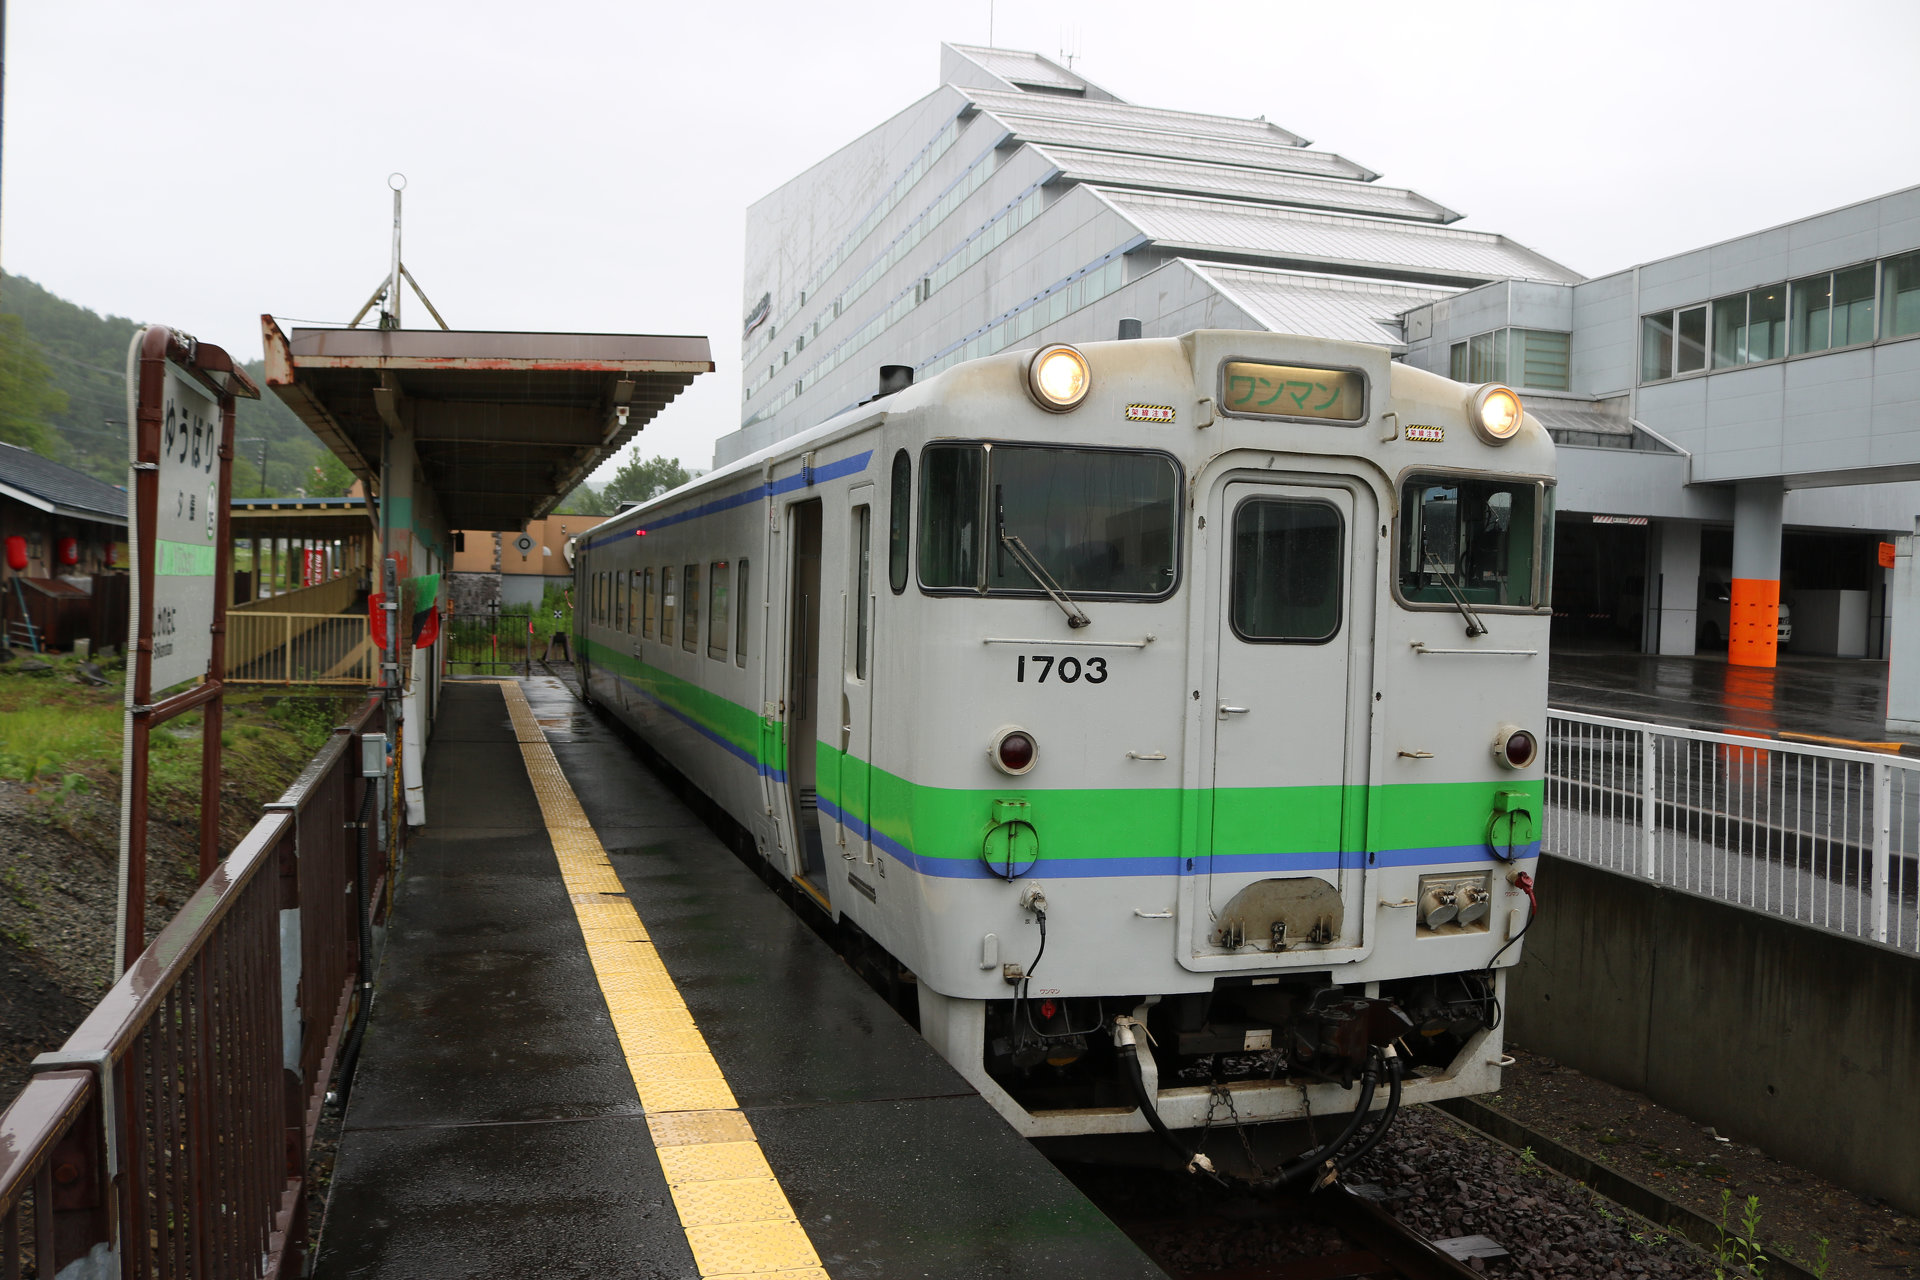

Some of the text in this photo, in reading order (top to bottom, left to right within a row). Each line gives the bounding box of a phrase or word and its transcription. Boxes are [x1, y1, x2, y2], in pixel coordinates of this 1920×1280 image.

[1229, 375, 1341, 411] ワンマン
[1131, 408, 1169, 418] 架線注意
[164, 398, 214, 475] ゆうばり
[1017, 655, 1108, 684] 1703
